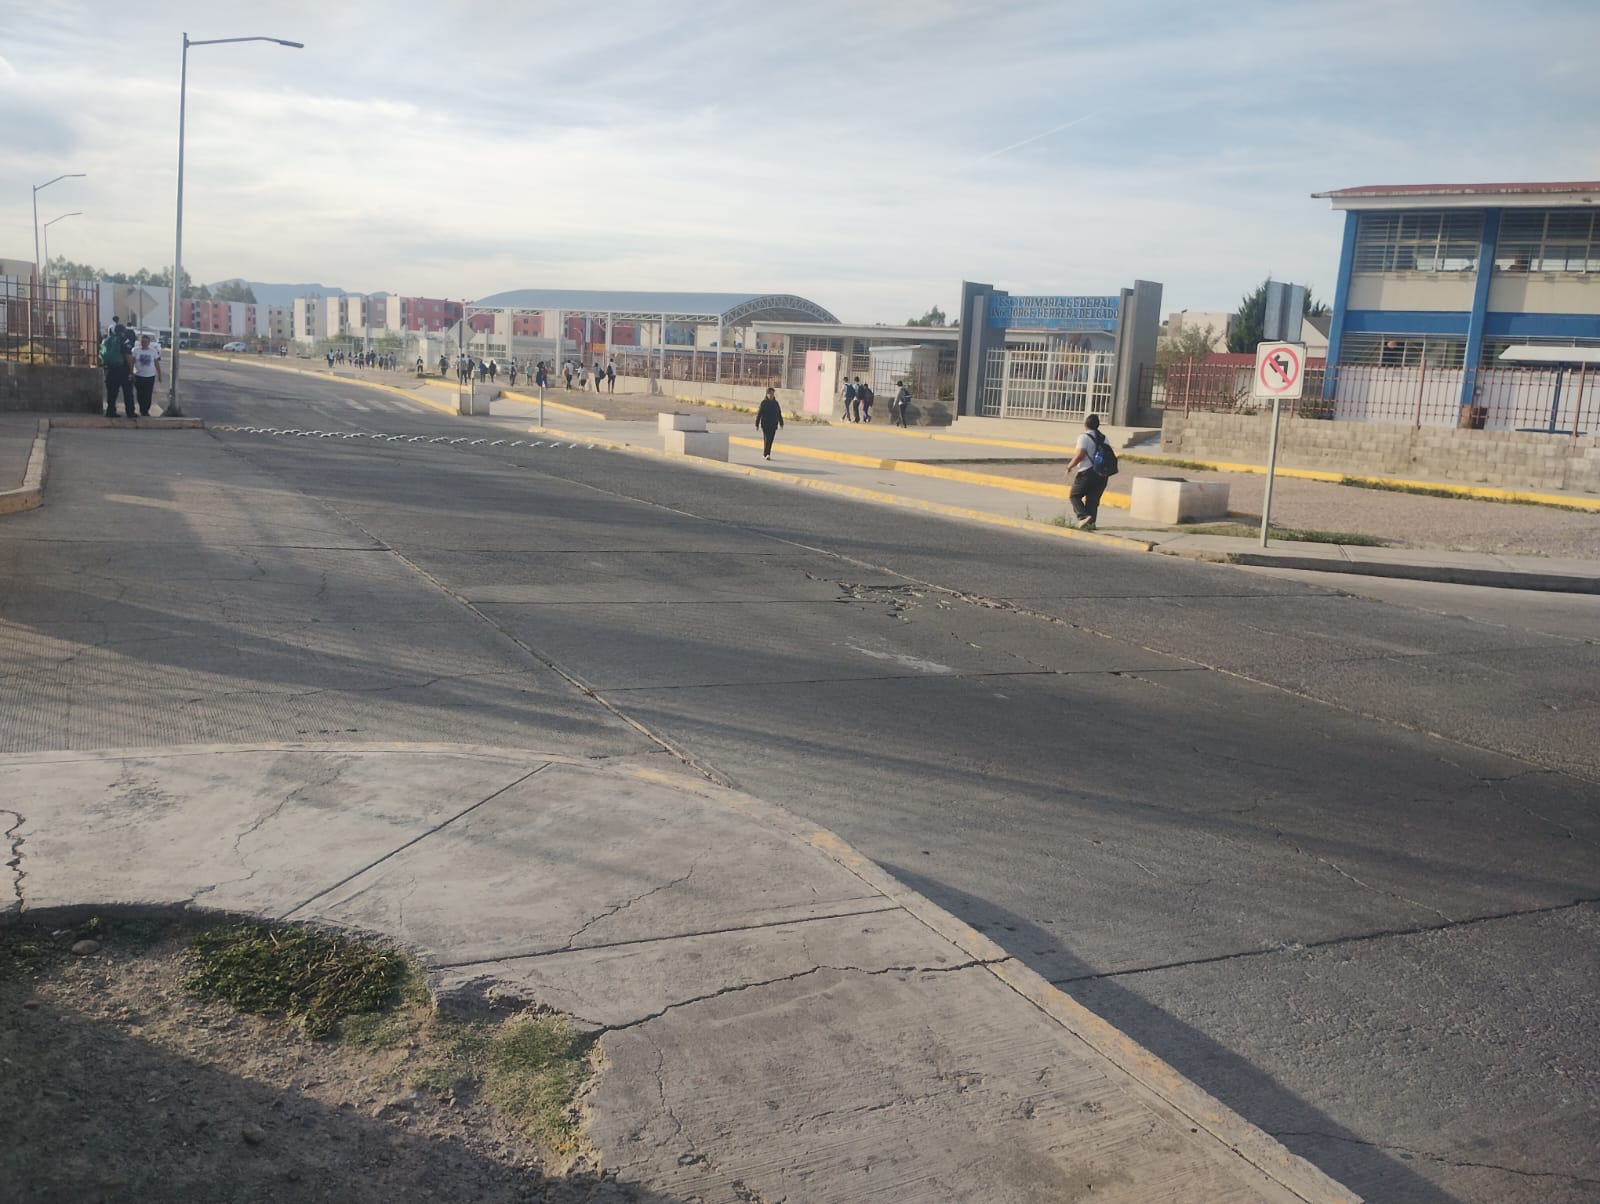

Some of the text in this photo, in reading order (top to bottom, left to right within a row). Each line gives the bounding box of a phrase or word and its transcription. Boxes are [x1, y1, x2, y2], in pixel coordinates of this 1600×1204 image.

[1018, 296, 1063, 308] PRIMARIA
[1066, 296, 1112, 308] FEDERAL
[1009, 307, 1035, 318] JORGE
[1037, 307, 1076, 319] HERRERA
[1079, 308, 1118, 320] DELGADO
